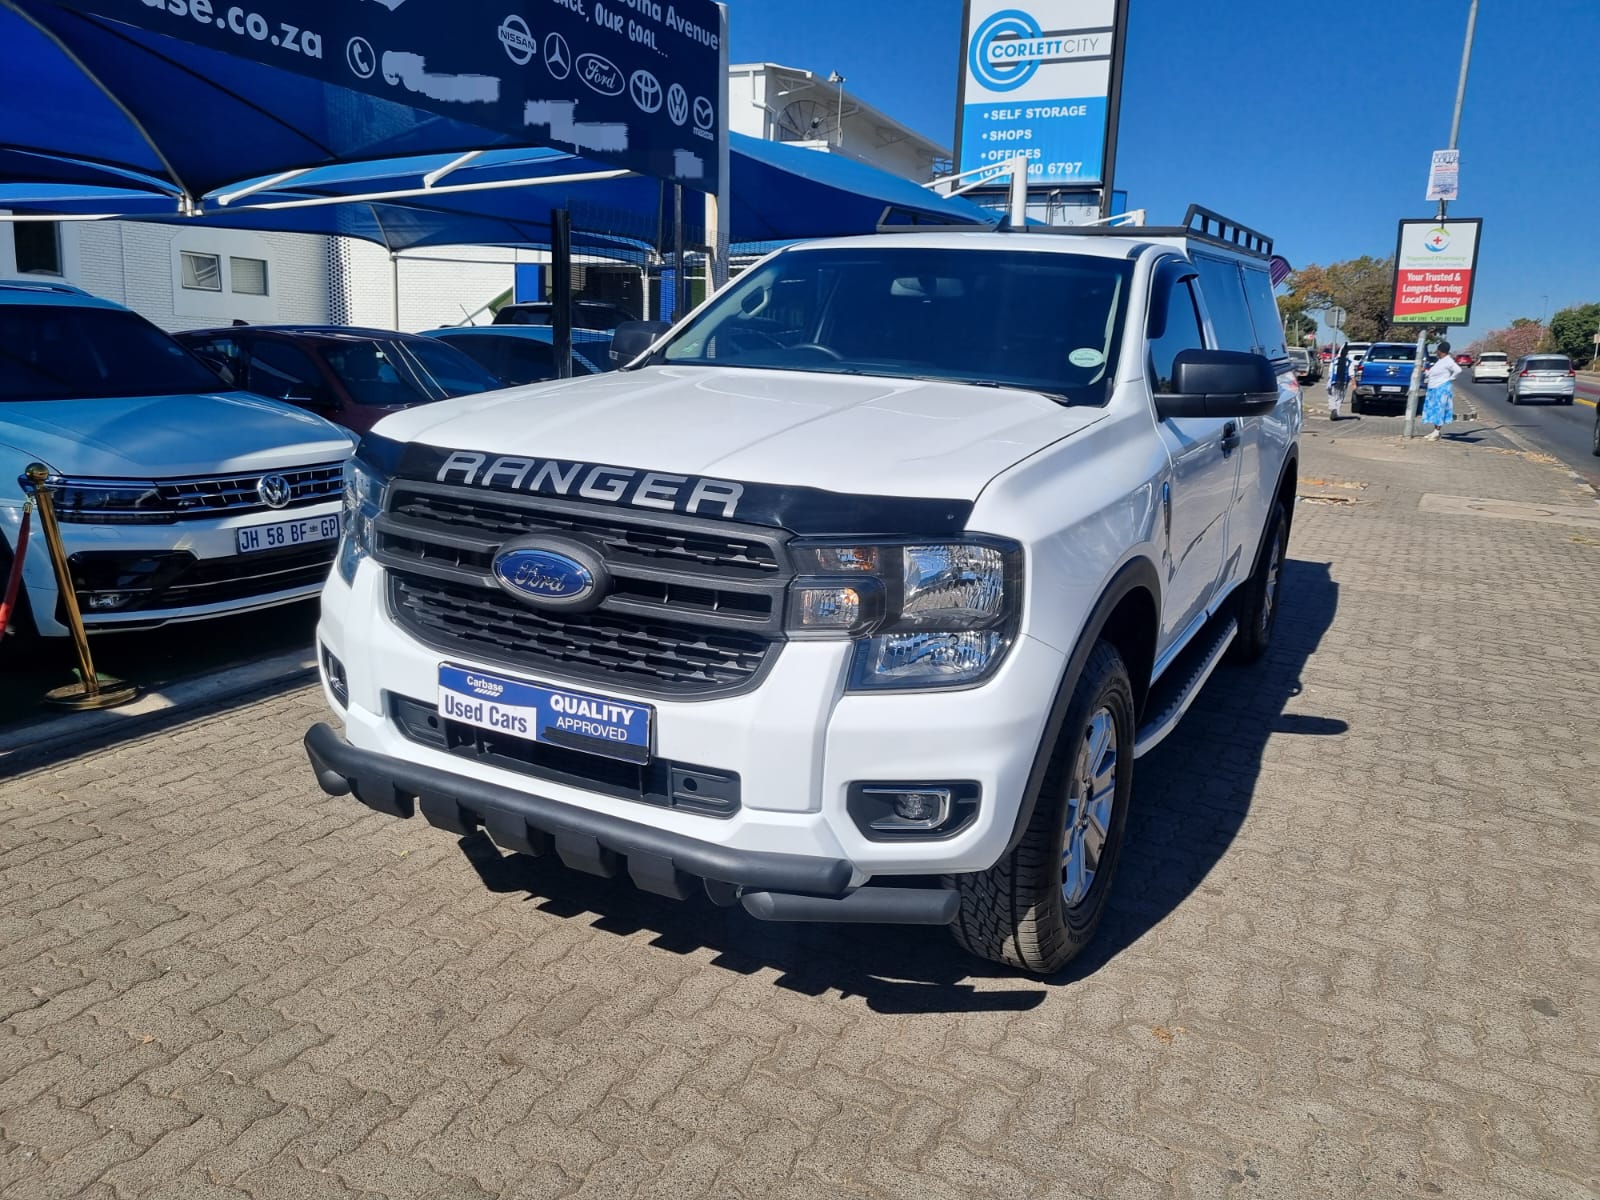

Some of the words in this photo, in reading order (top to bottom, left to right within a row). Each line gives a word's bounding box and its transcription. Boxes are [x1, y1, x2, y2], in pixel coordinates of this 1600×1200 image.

[594, 3, 624, 34] OUR
[665, 5, 719, 50] Avenue
[500, 29, 535, 50] NISSAN
[585, 58, 616, 89] Ford
[990, 108, 1022, 121] SELF
[1025, 105, 1087, 119] STORAGE
[989, 129, 1032, 141] SHOPS
[987, 148, 1041, 161] OFFICES
[1047, 162, 1083, 174] 6797
[1407, 272, 1424, 281] Your
[1425, 272, 1454, 281] Trusted
[1401, 296, 1422, 304] Local
[1423, 295, 1461, 306] Pharmacy
[1402, 284, 1432, 294] Longest
[1433, 284, 1463, 295] Serving
[436, 451, 744, 517] RANGER
[241, 530, 259, 550] JH
[266, 527, 285, 546] 58
[290, 523, 307, 542] BF
[320, 518, 336, 537] GP
[515, 560, 565, 593] Ford
[466, 676, 504, 693] Carbase
[444, 694, 483, 722] Used
[489, 705, 528, 734] Cars
[550, 695, 635, 726] QUALITY
[556, 716, 628, 741] APPROVED
